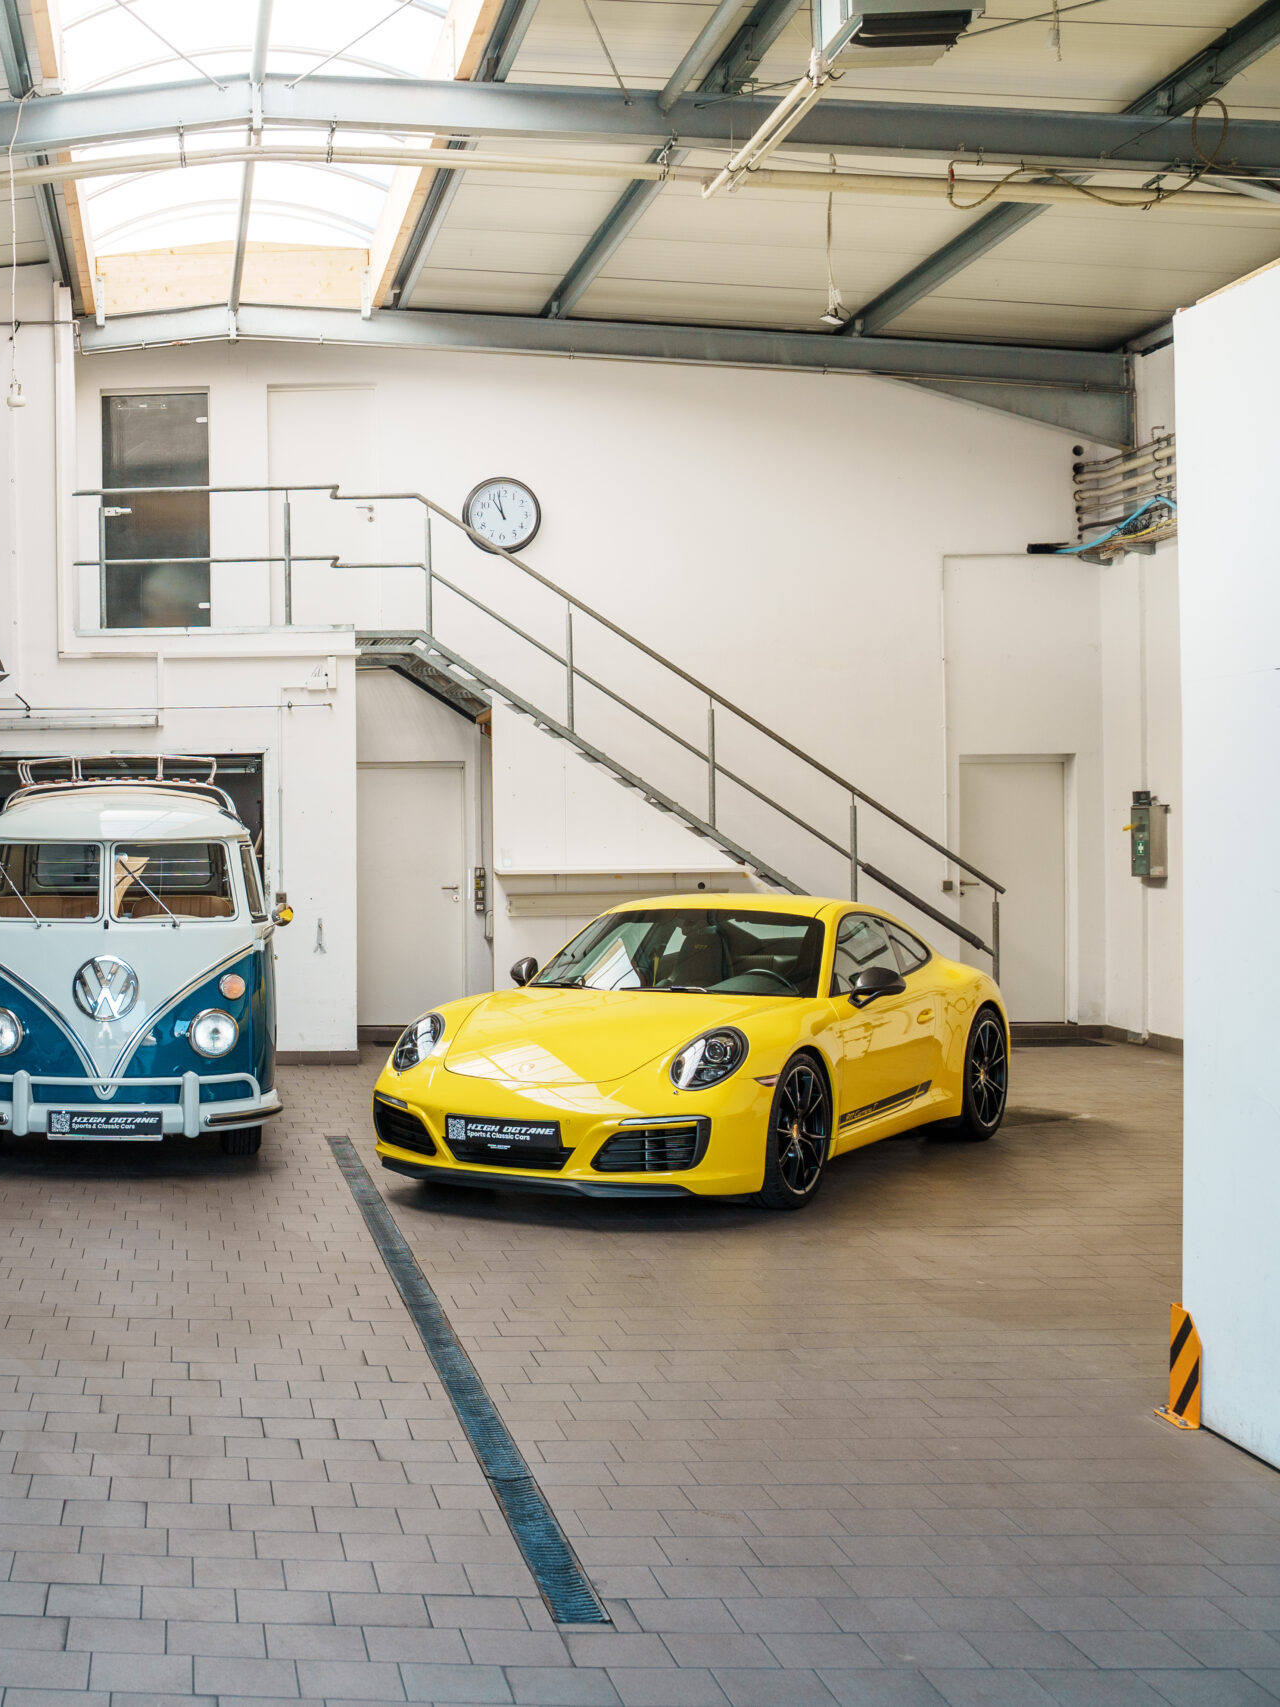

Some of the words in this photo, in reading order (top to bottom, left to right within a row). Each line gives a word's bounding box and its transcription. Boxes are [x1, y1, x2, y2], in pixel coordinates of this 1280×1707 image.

[467, 1123, 500, 1132] HIGH
[503, 1125, 555, 1135] OCTANE
[466, 1130, 486, 1139] Sports
[491, 1132, 514, 1140] Classic
